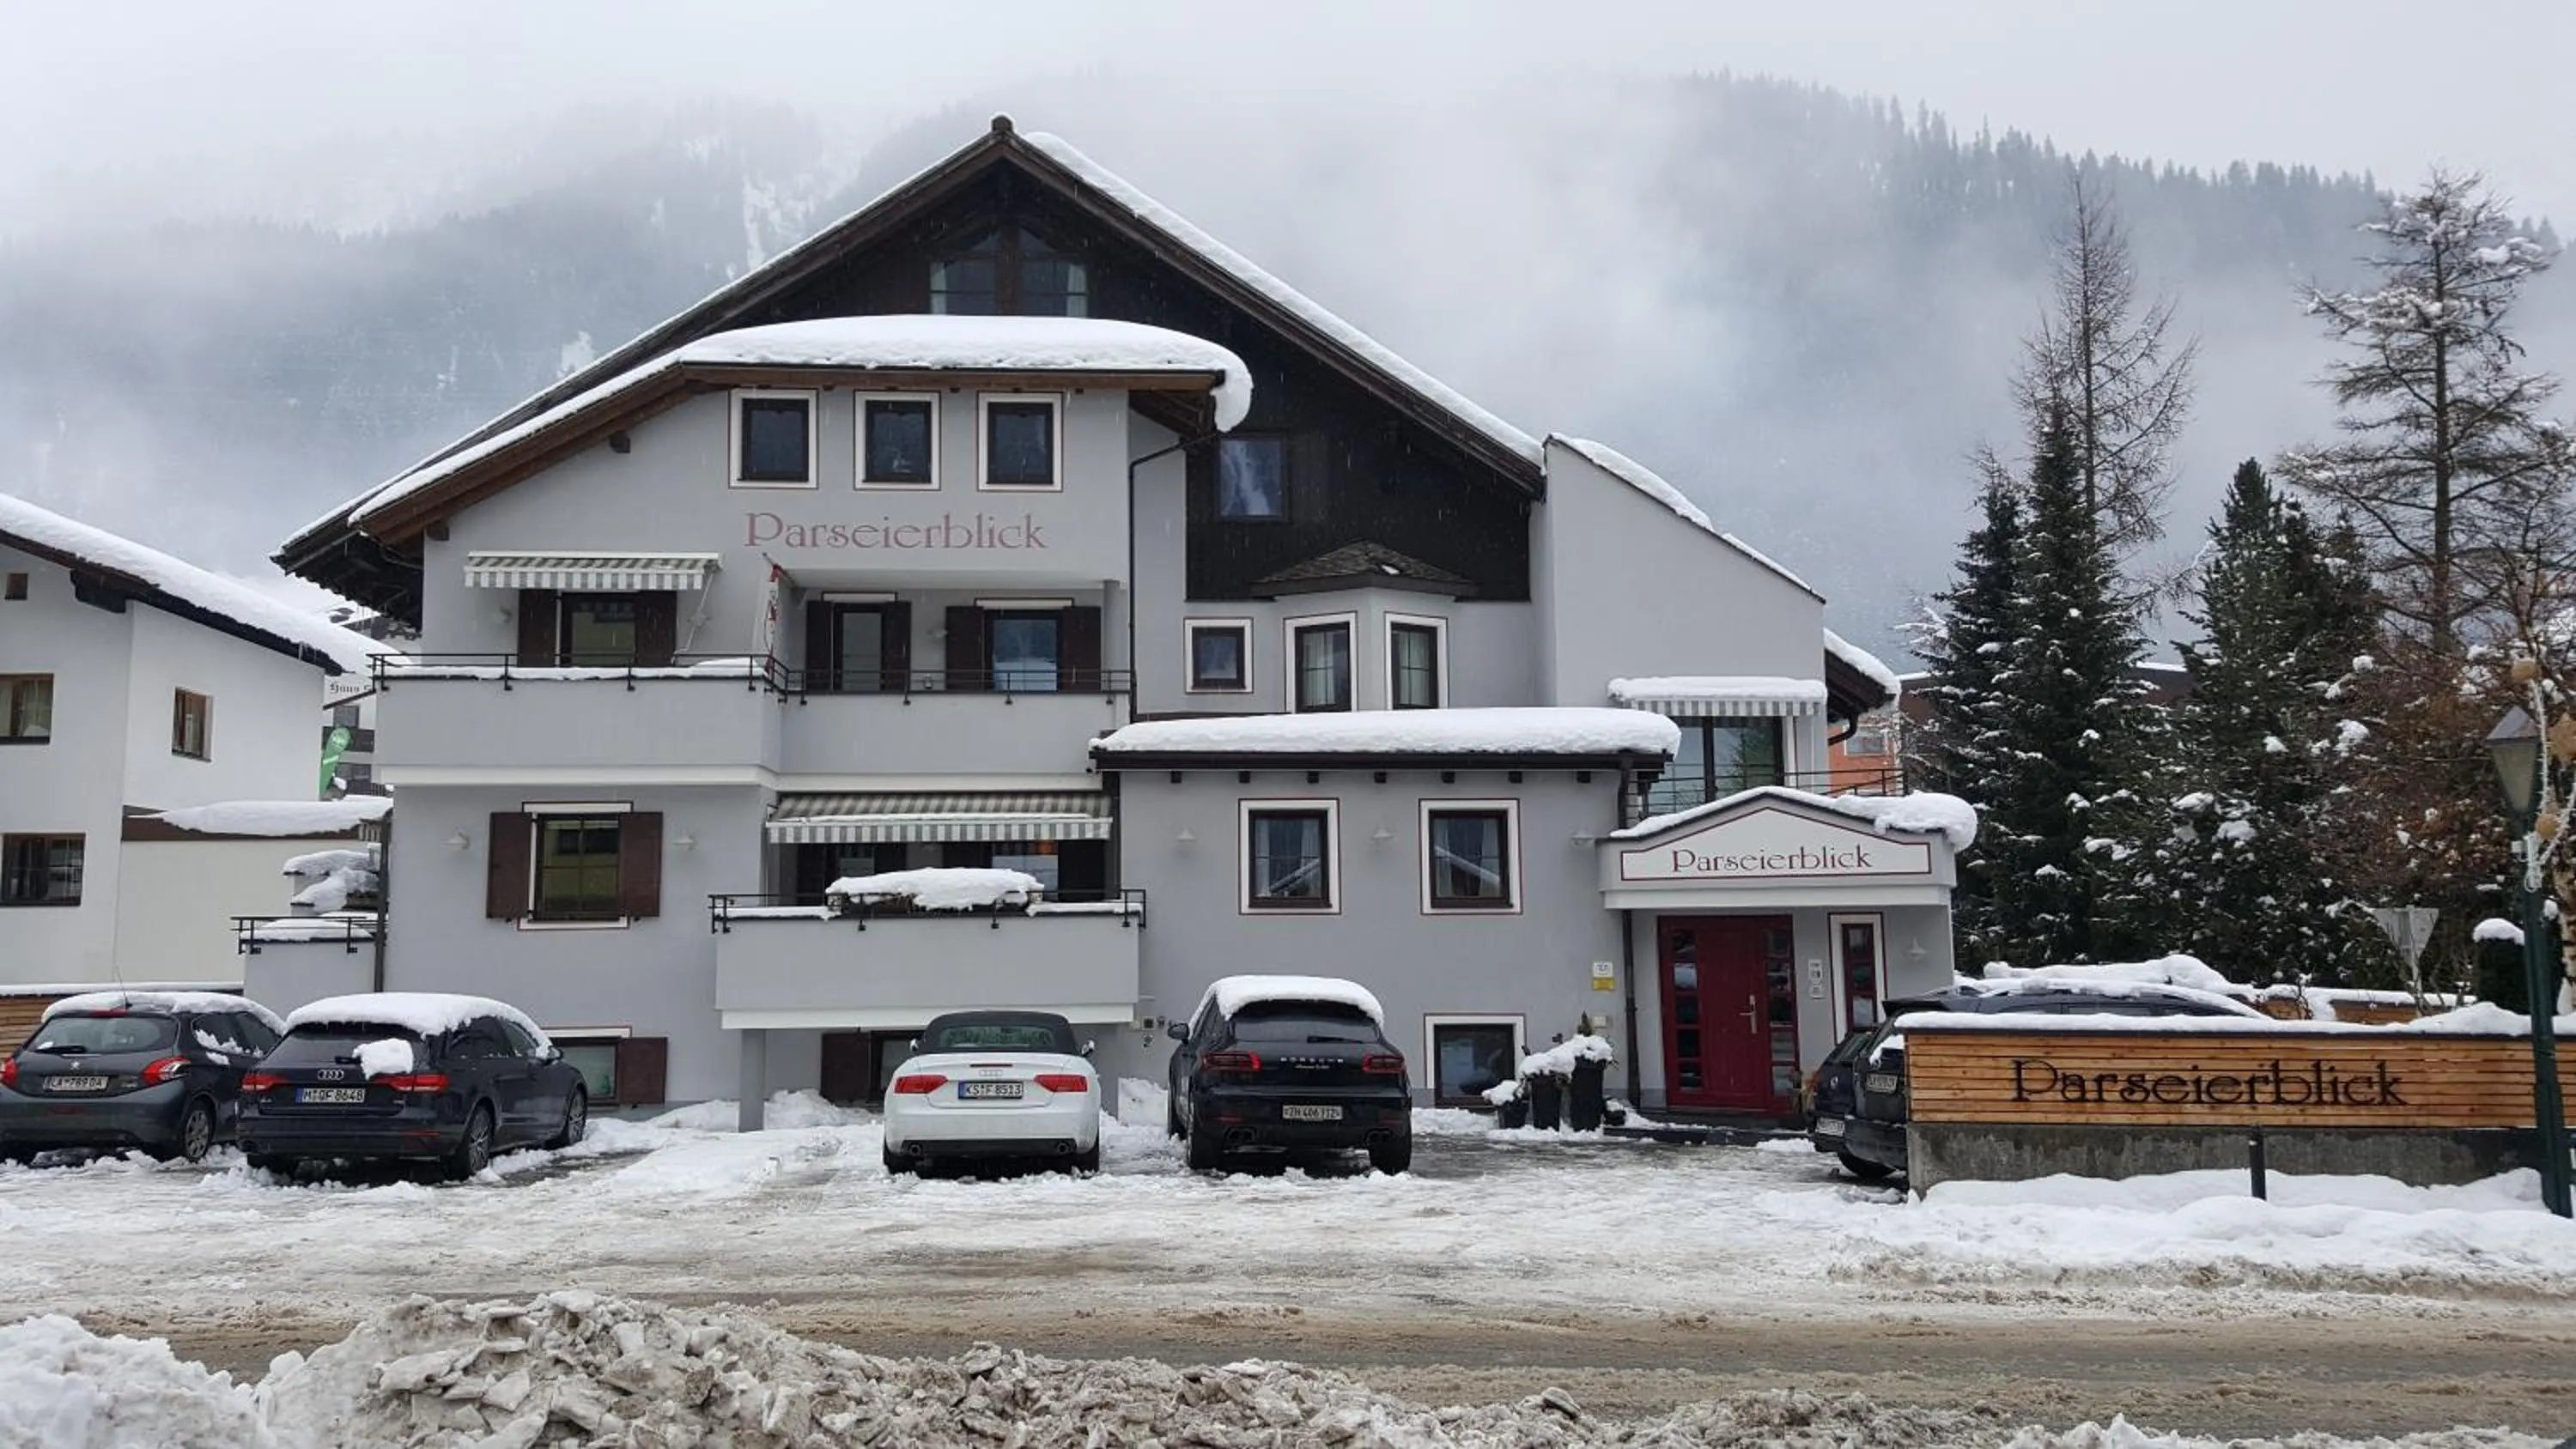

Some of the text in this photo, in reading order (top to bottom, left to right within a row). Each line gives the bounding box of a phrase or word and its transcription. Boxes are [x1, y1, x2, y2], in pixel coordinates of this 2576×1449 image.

[744, 512, 1049, 549] Parseierblick
[1671, 844, 1874, 873] Parseierblick
[2011, 1058, 2409, 1106] Parseierblick
